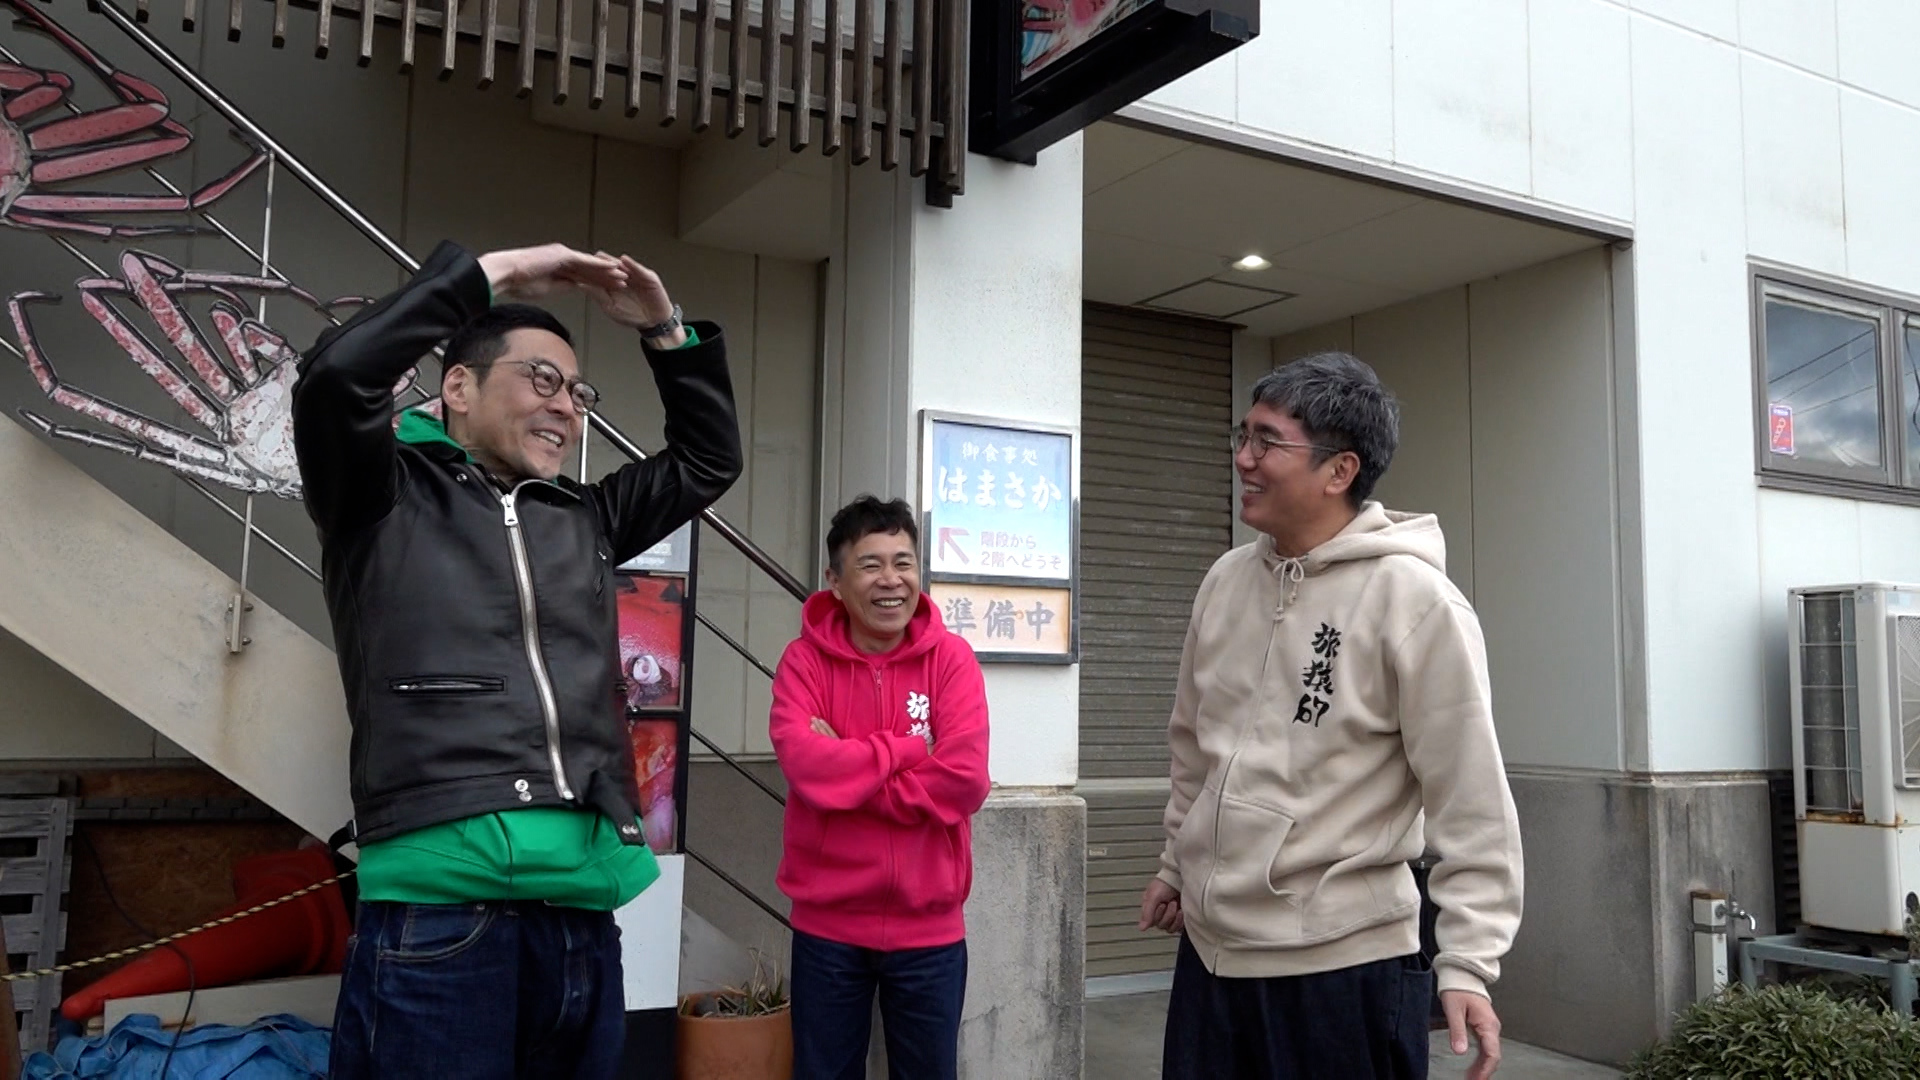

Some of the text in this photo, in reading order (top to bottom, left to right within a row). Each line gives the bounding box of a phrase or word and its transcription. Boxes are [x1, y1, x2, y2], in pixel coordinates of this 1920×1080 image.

[962, 441, 1038, 466] 御食事処
[939, 465, 1062, 511] はまさか
[981, 531, 1036, 549] 階段から
[945, 597, 1055, 641] 準備中
